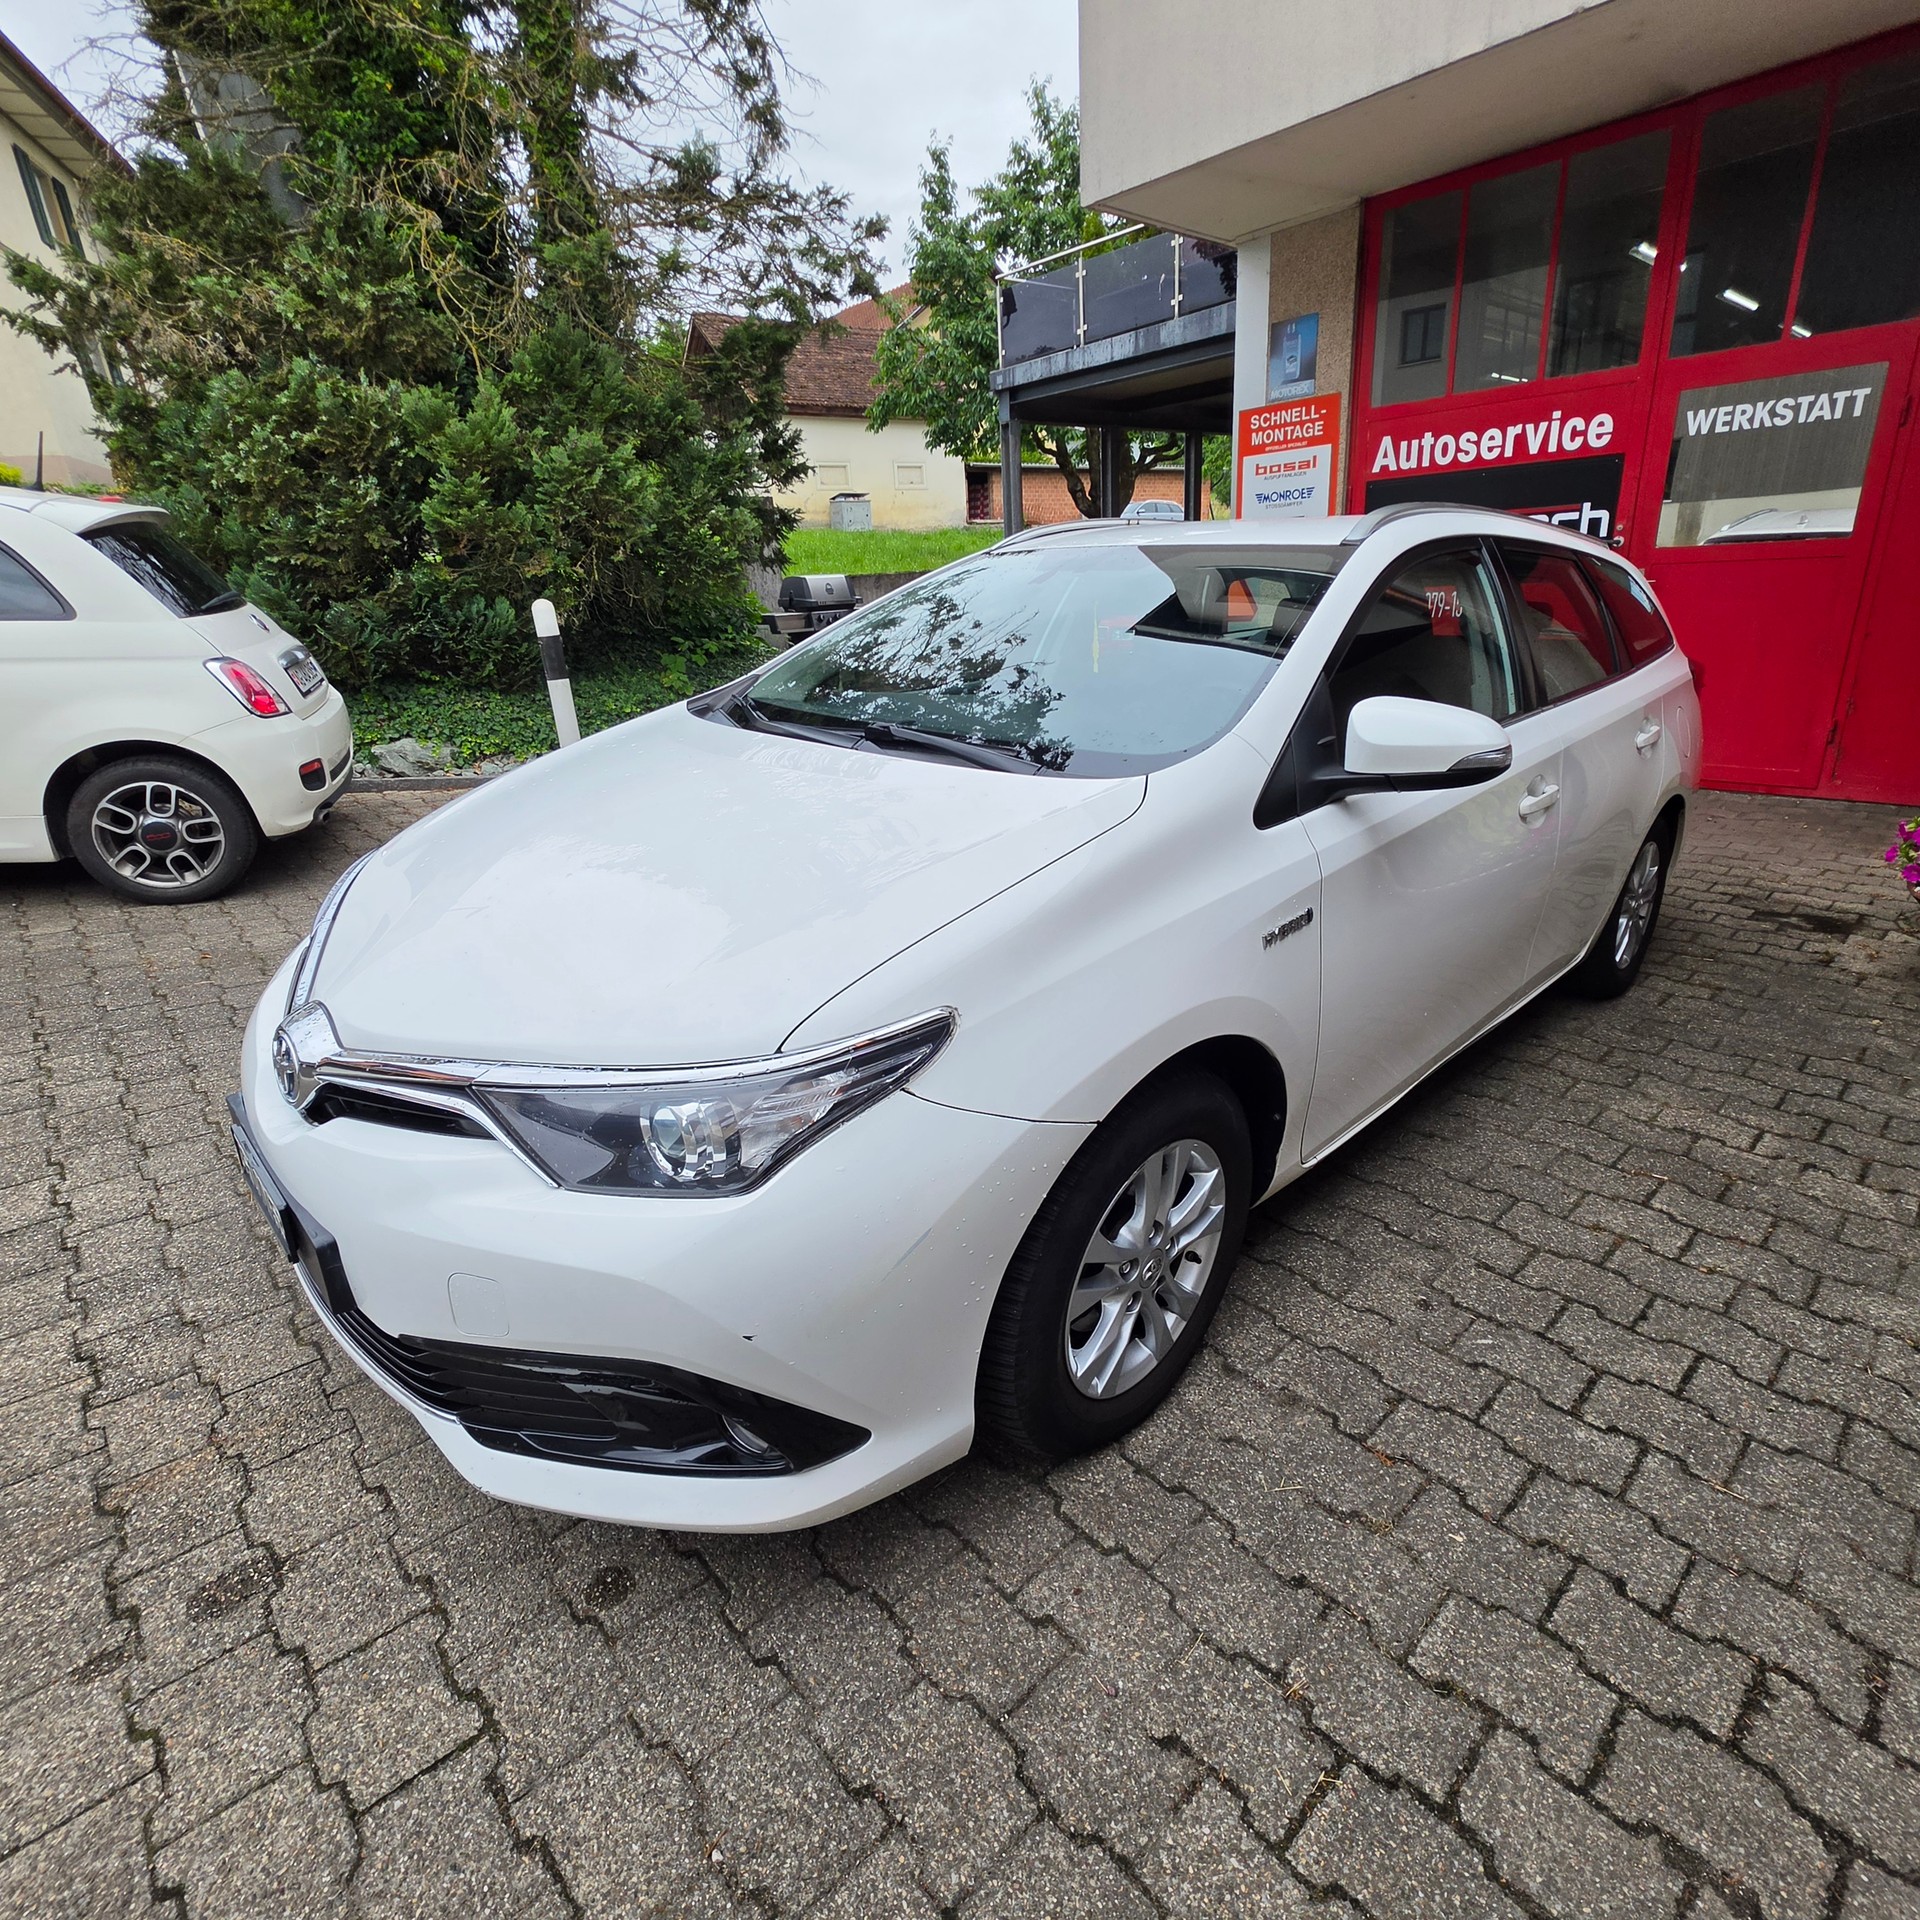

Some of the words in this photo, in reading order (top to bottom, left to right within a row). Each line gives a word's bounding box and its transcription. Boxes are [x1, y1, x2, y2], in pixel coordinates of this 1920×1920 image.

[1270, 385, 1310, 400] MOTOREX
[1250, 404, 1327, 429] SCHNELL-
[1686, 387, 1872, 437] WERKSTATT
[1251, 420, 1324, 446] MONTAGE
[1371, 410, 1614, 474] Autoservice
[1255, 455, 1317, 476] bosal
[1262, 487, 1307, 503] MONROE
